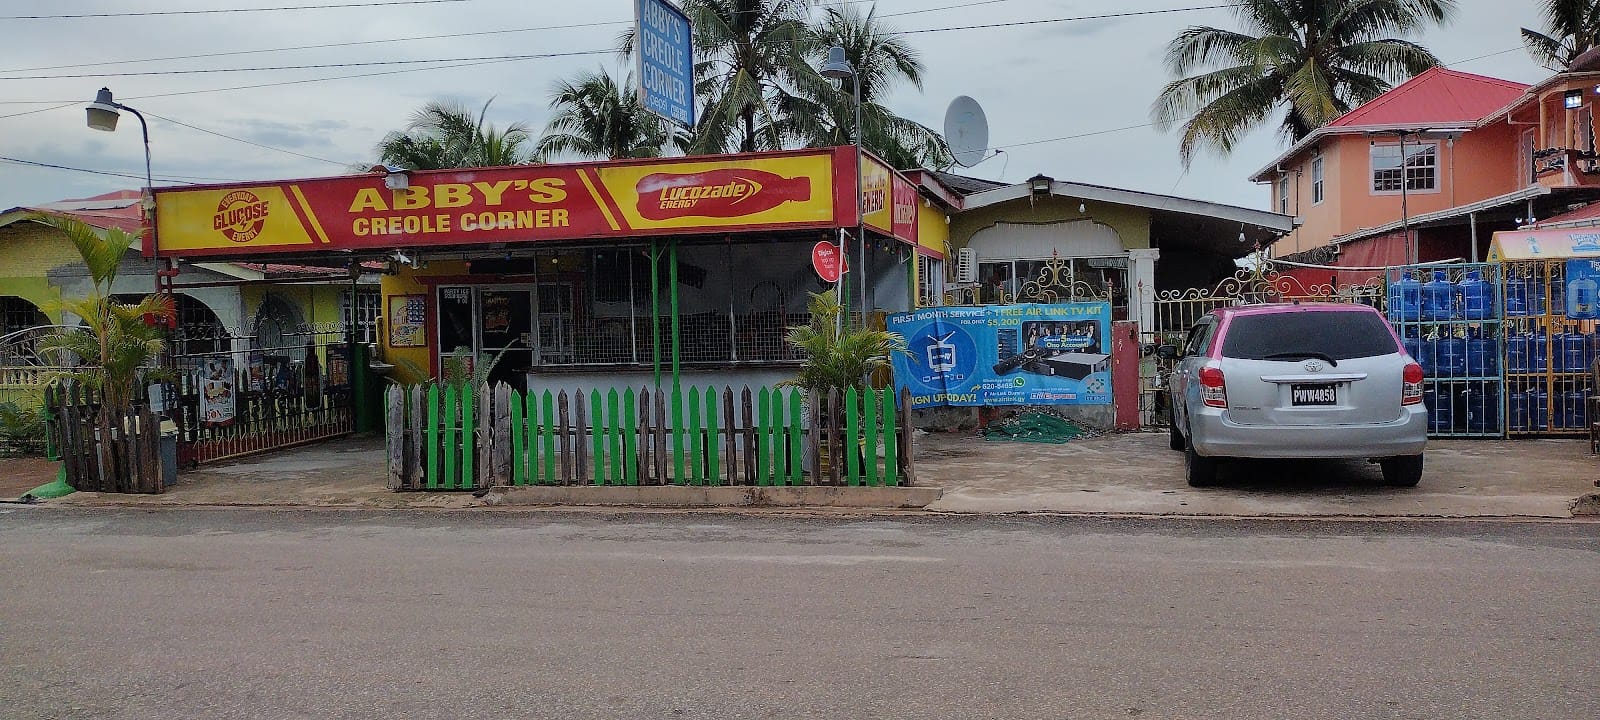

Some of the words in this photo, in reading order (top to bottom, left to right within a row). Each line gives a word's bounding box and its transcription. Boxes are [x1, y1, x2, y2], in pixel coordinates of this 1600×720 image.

[644, 0, 681, 45] ABBY'S
[643, 28, 684, 77] CREOLE
[643, 62, 687, 107] CORNER
[650, 94, 668, 112] pepsi
[222, 191, 254, 208] EVERYDAY
[348, 177, 568, 213] ABBY'S
[659, 181, 747, 201] Lucozade
[659, 199, 698, 210] ENERGY
[213, 200, 269, 231] GLUCOSE
[352, 214, 451, 236] CREOLE
[460, 208, 570, 232] CORNER
[231, 227, 258, 242] ENERGY
[892, 314, 916, 325] FIRST
[917, 310, 948, 321] MONTH
[949, 309, 985, 318] SERVICE
[1001, 307, 1023, 316] FREE
[1025, 307, 1042, 316] AIR
[1044, 307, 1068, 316] LINK
[1070, 307, 1084, 315] TV
[1086, 306, 1102, 315] KIT
[987, 318, 1021, 328] $5,200!
[911, 394, 931, 405] IGN
[1293, 388, 1336, 403] PWW4858
